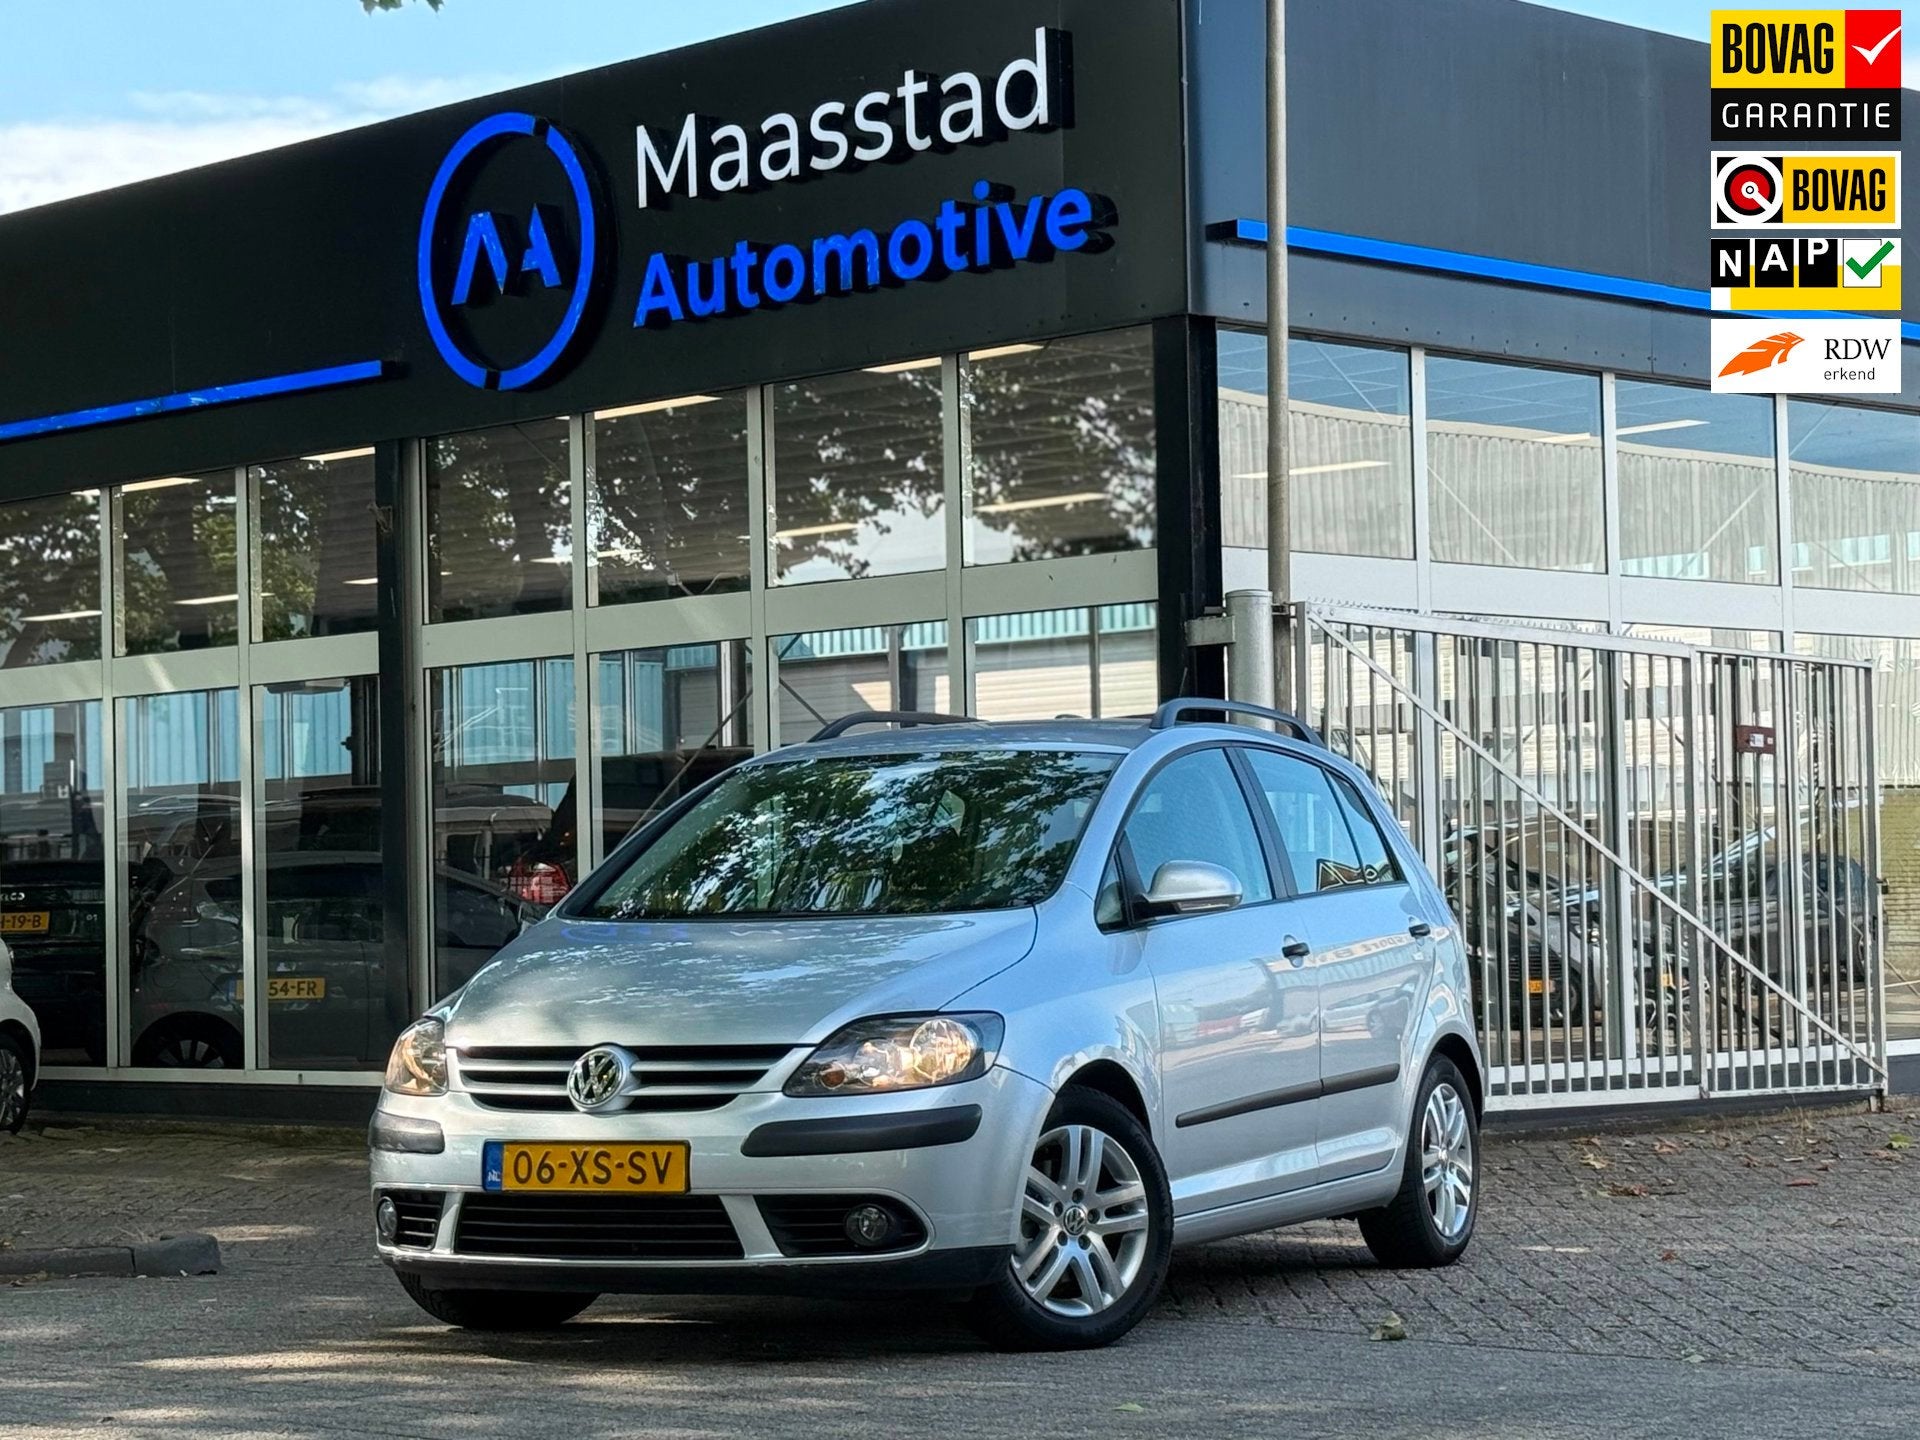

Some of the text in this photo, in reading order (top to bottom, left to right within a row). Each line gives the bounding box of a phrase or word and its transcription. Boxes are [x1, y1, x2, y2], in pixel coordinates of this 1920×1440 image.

[635, 26, 1050, 209] Maasstad
[633, 179, 1093, 328] Automotive
[268, 981, 318, 997] 54-FR
[512, 1150, 673, 1185] 06-XS-SV
